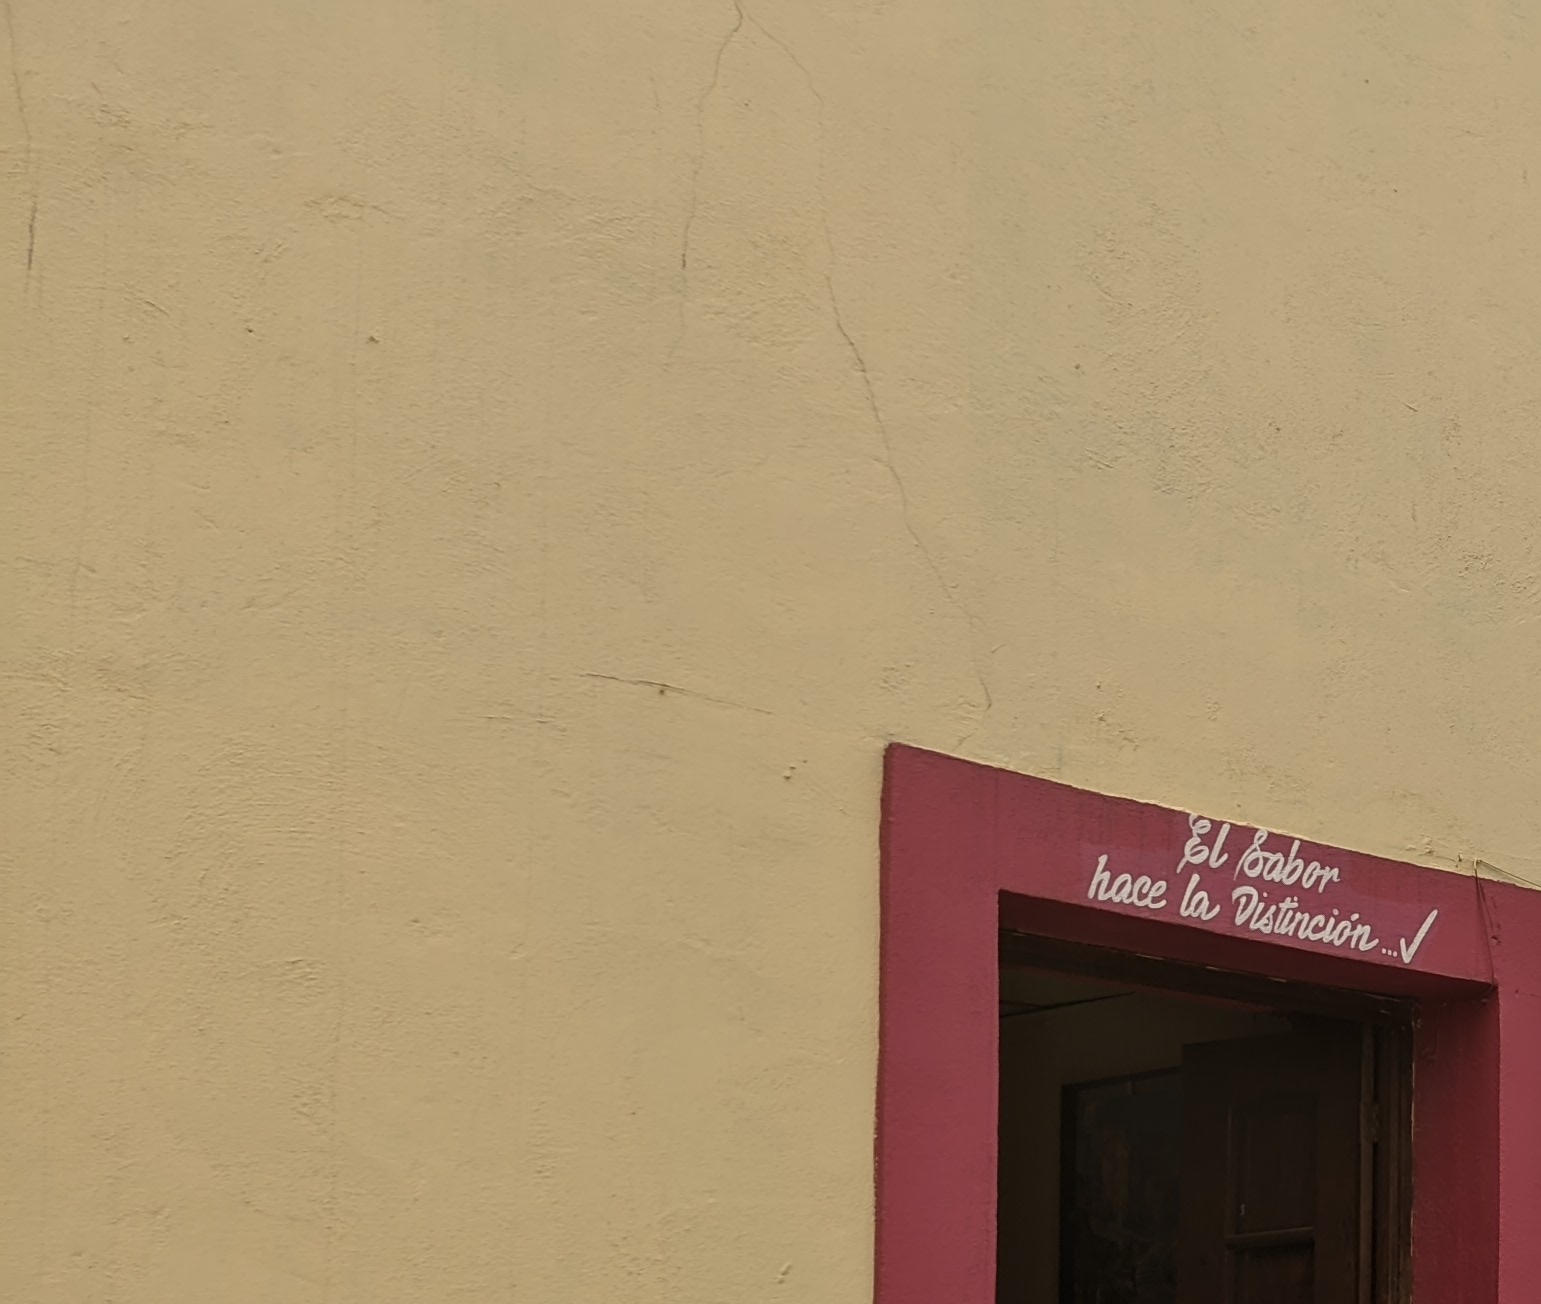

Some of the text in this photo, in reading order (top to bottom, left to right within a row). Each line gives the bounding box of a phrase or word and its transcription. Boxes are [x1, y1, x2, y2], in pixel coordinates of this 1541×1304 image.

[1087, 853, 1168, 909] hace
[1179, 873, 1221, 921] la
[1176, 813, 1341, 893] El Sabor
